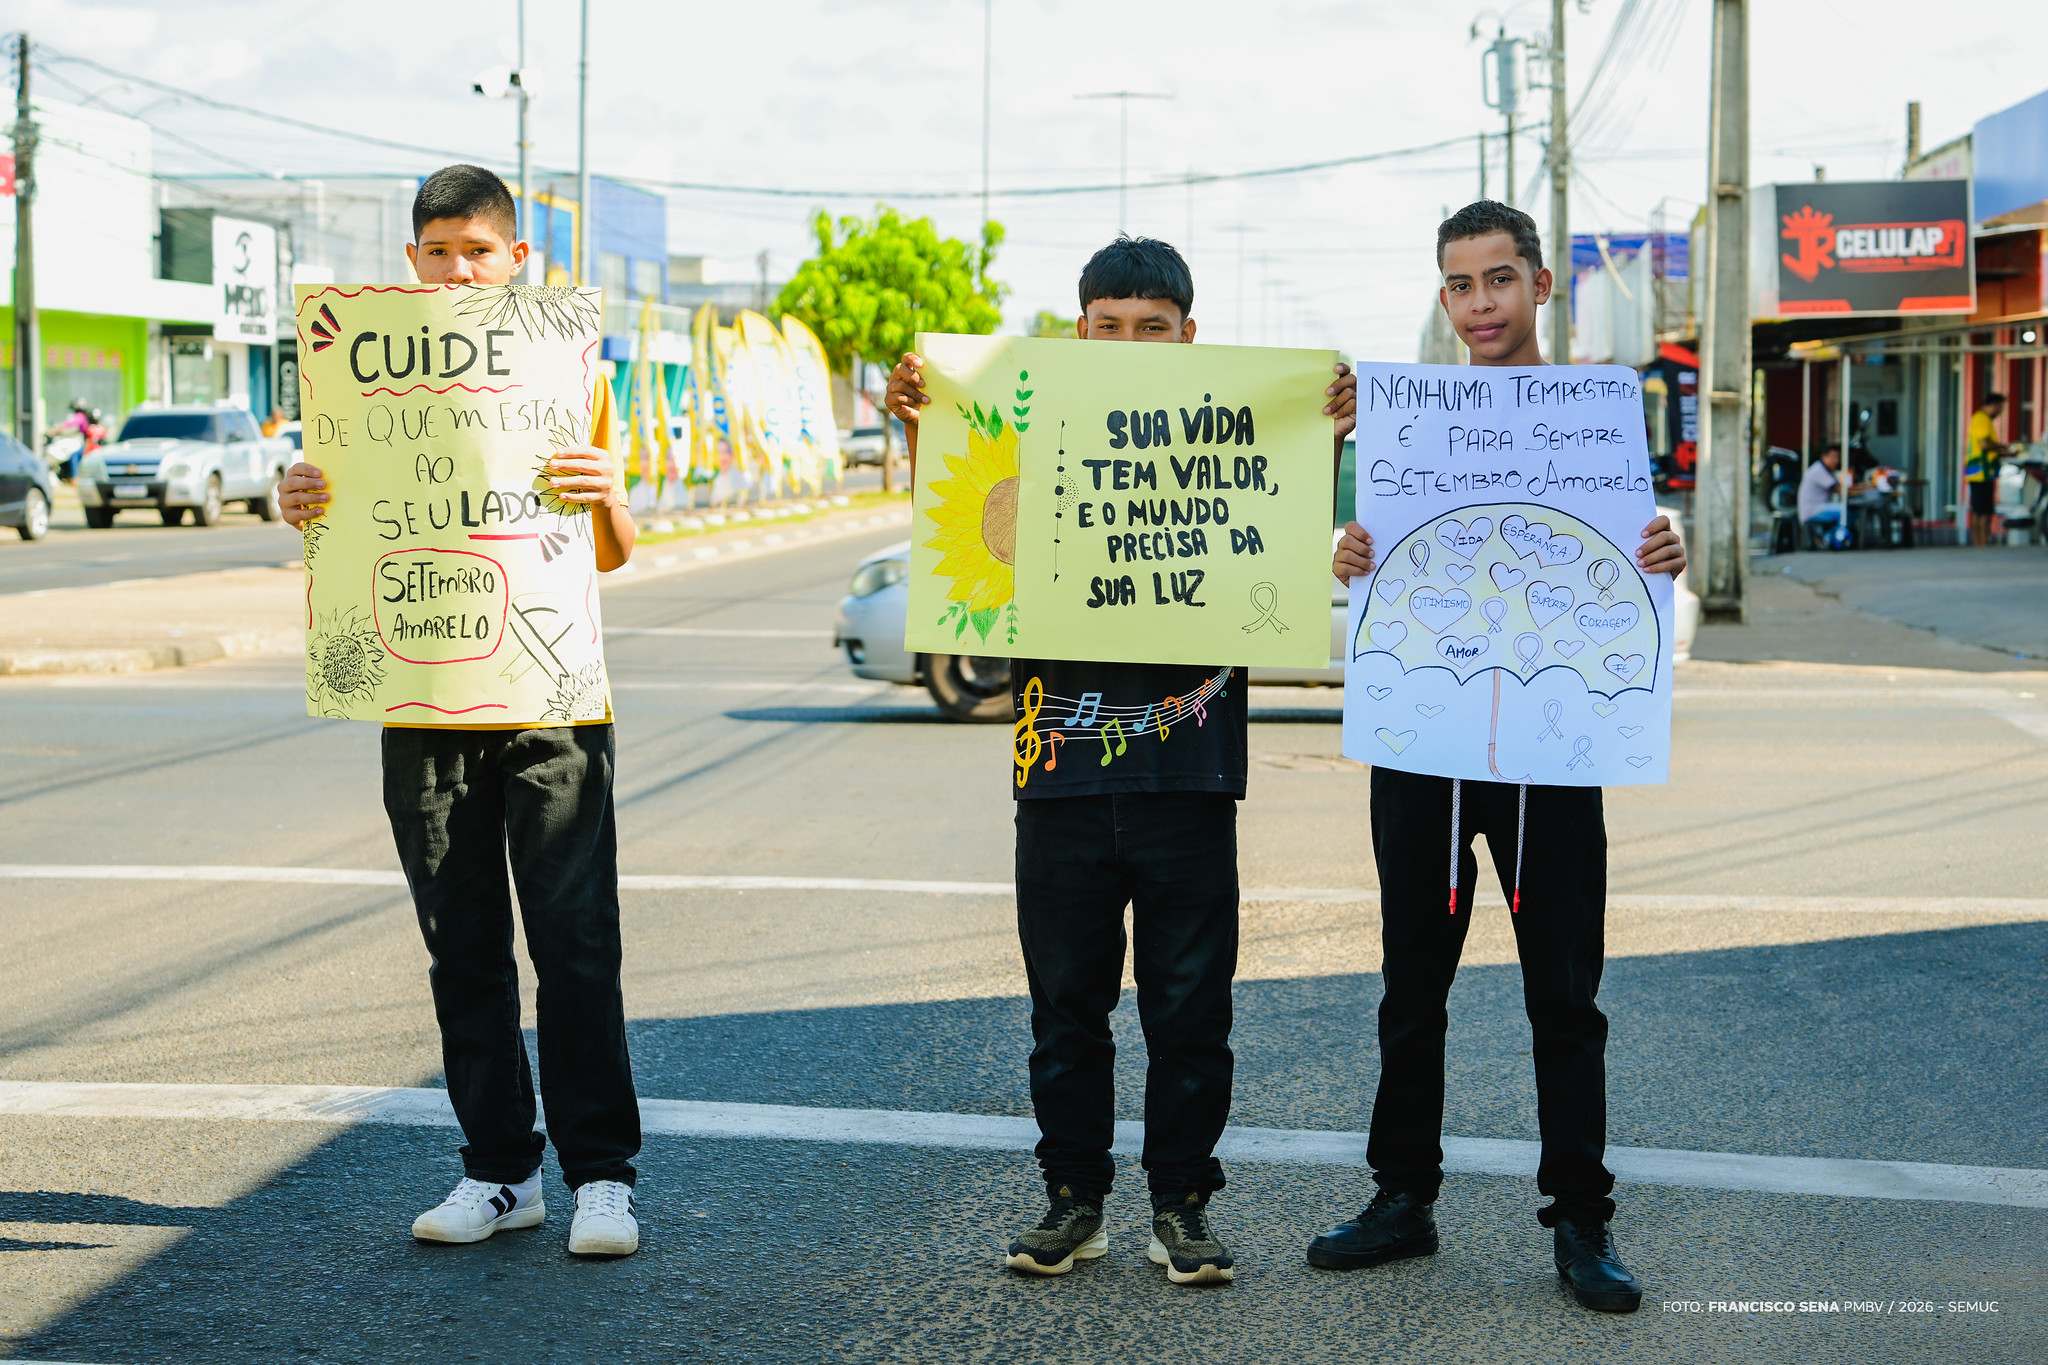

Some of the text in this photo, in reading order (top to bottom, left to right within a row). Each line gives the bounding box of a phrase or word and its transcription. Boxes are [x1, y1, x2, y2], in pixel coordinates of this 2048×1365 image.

[1370, 374, 1492, 411] NENHUMA
[1509, 375, 1638, 407] TEMPESTADE
[312, 413, 348, 447] DE
[500, 399, 557, 432] ESTÁ
[1106, 409, 1171, 449] SUA
[1398, 415, 1626, 456] É PARA SEMPRE
[415, 453, 454, 485] AO
[1081, 454, 1279, 496] TEM VALOR,
[1370, 459, 1522, 497] SETEMBRO
[372, 490, 542, 541] SEU LADO
[1078, 497, 1230, 528] E O MUNDO
[1229, 525, 1264, 556] DA
[1441, 529, 1484, 548] VIDA
[1086, 569, 1206, 608] SUA LUZ
[1412, 595, 1470, 610] OTIMISMO
[1531, 590, 1569, 612] SUPORTE
[1579, 615, 1631, 630] CORAGEM
[1445, 644, 1479, 659] AMOR
